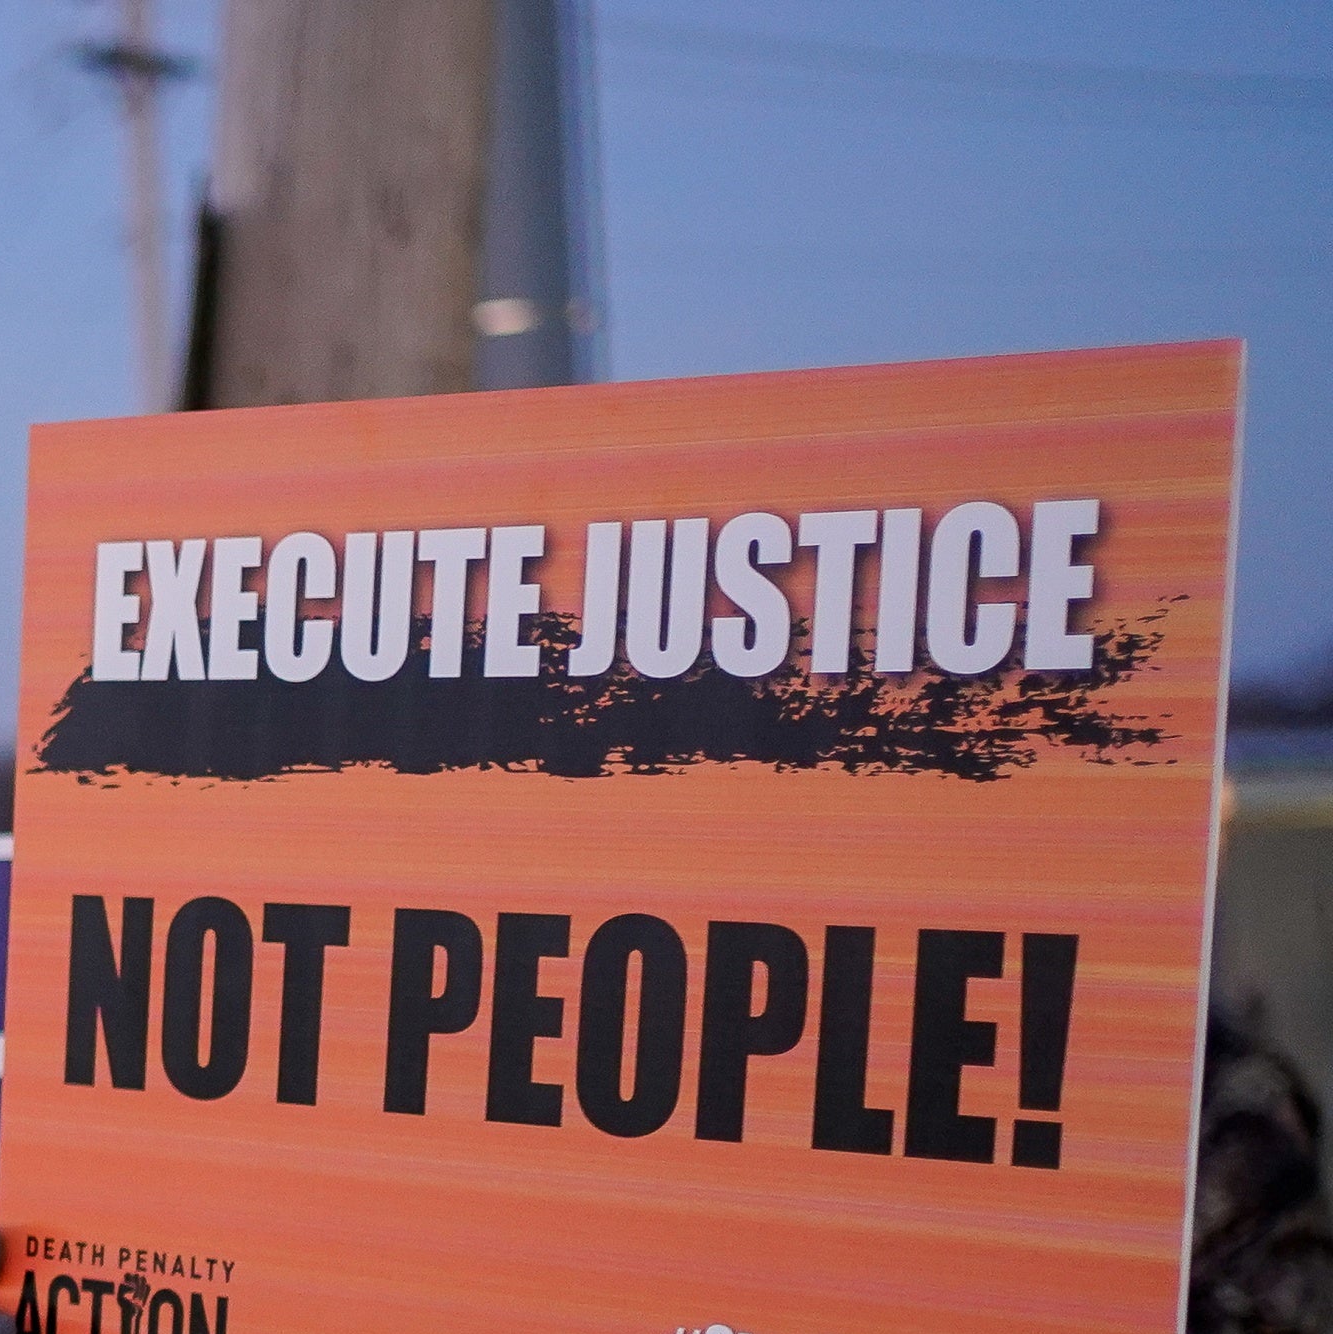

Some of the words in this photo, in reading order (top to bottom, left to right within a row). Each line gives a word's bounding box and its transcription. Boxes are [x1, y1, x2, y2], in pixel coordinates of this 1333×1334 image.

[91, 523, 545, 683] EXECUTE
[567, 498, 1101, 679] JUSTICE
[63, 894, 351, 1106] NOT
[383, 906, 1080, 1169] PEOPLE!
[25, 1235, 106, 1267] DEATH
[118, 1247, 236, 1283] PENALTY
